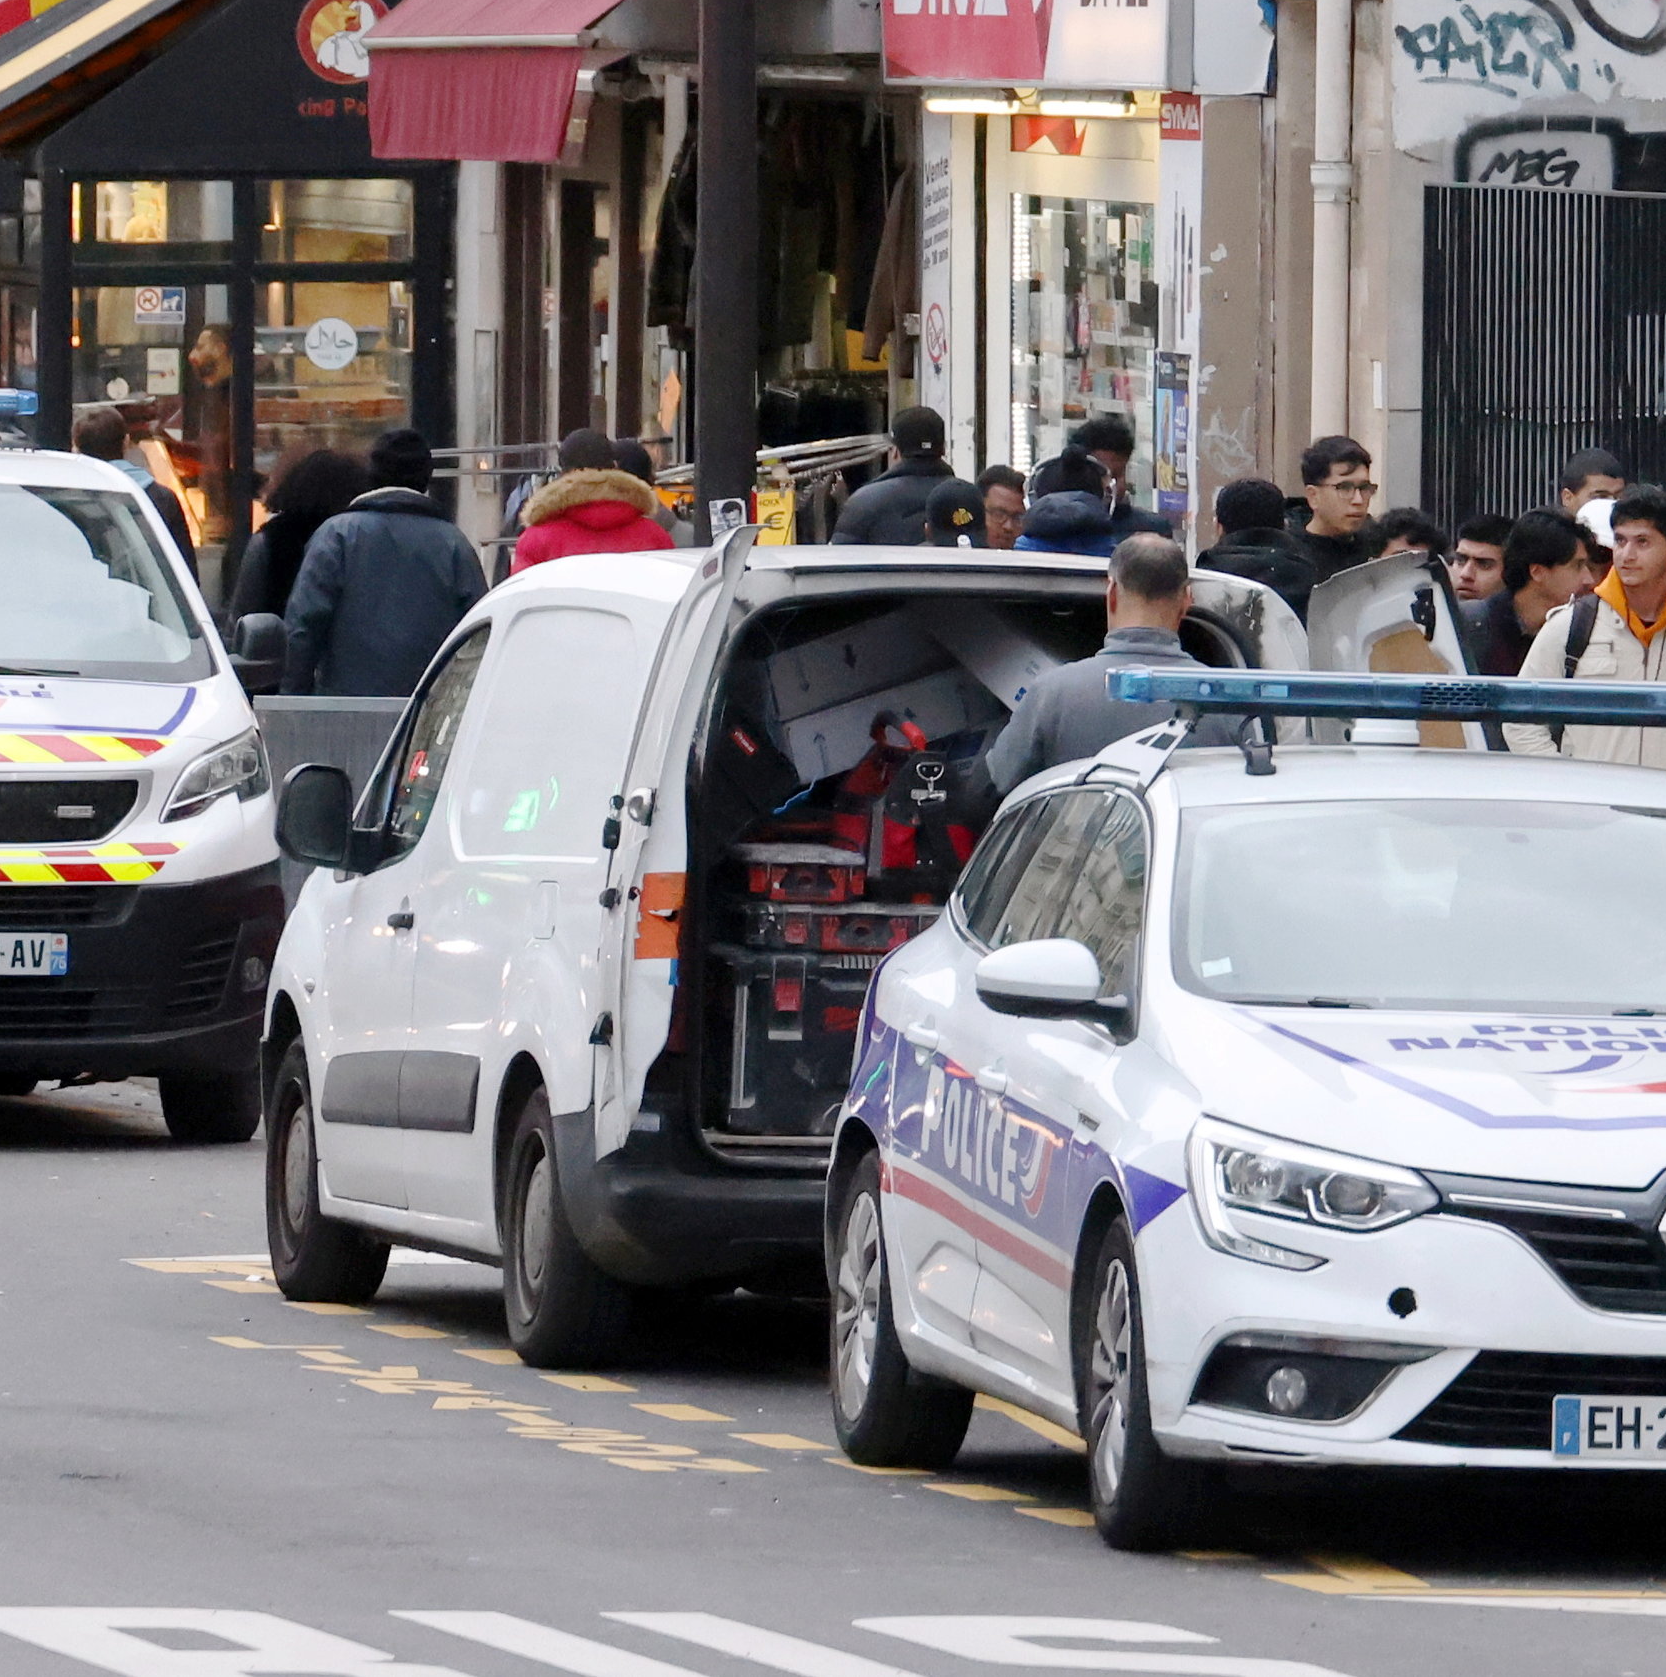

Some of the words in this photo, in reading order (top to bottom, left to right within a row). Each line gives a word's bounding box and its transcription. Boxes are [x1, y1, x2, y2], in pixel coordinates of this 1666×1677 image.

[343, 96, 367, 117] Po
[1161, 103, 1199, 131] SYMA
[919, 1063, 1020, 1207] POLICE
